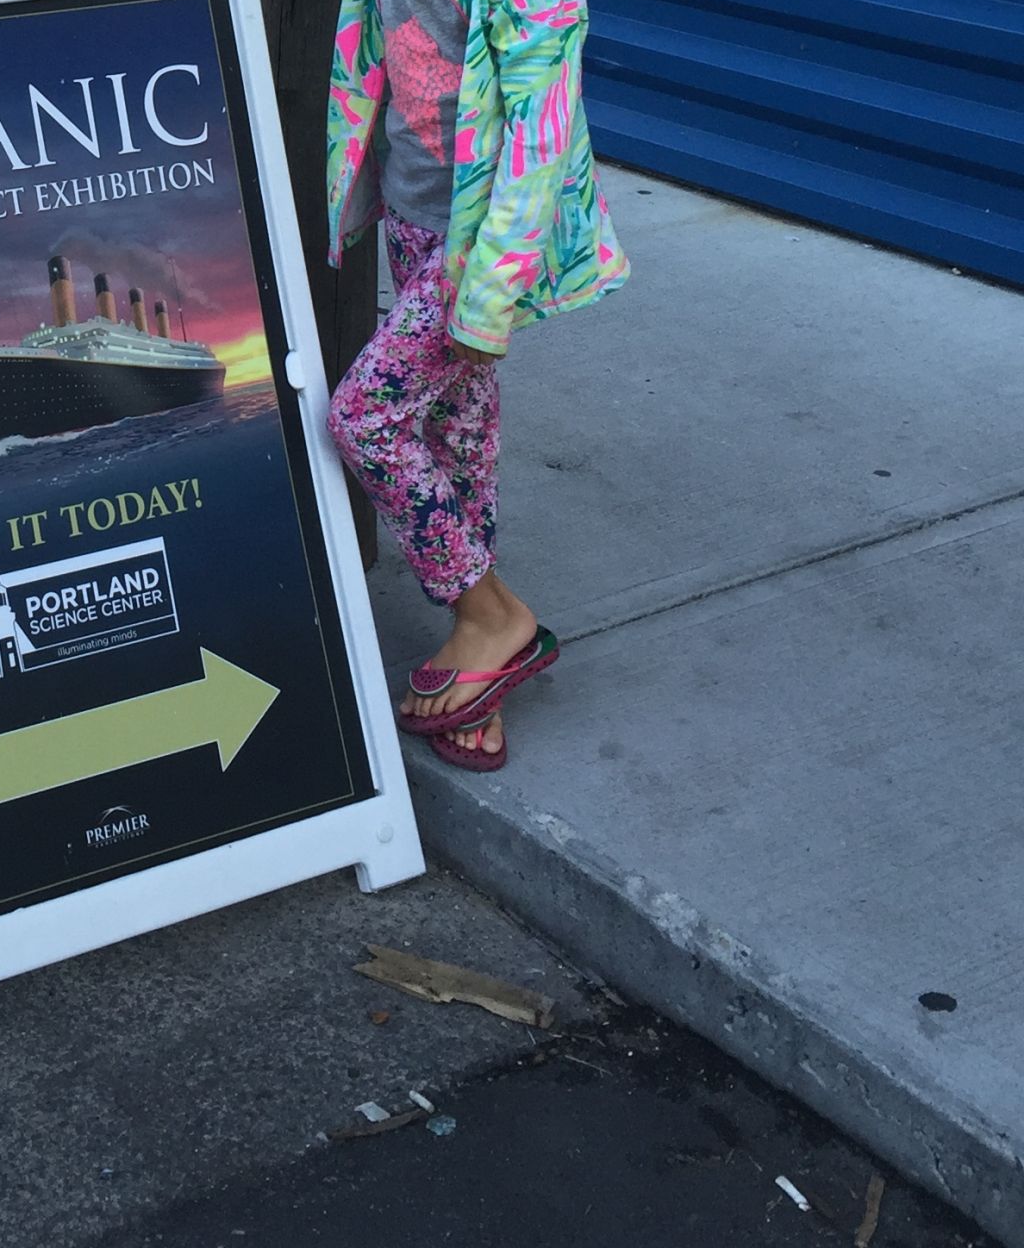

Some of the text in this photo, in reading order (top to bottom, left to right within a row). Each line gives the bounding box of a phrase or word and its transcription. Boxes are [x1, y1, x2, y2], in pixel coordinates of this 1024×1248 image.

[35, 157, 216, 212] EXHIBITION
[6, 510, 48, 551] IT
[60, 478, 203, 537] TODAY!
[25, 567, 160, 619] PORTLAND
[29, 589, 164, 635] SCIENCE CENTER
[57, 628, 138, 657] illuminating minds
[85, 813, 150, 844] PREMIER
